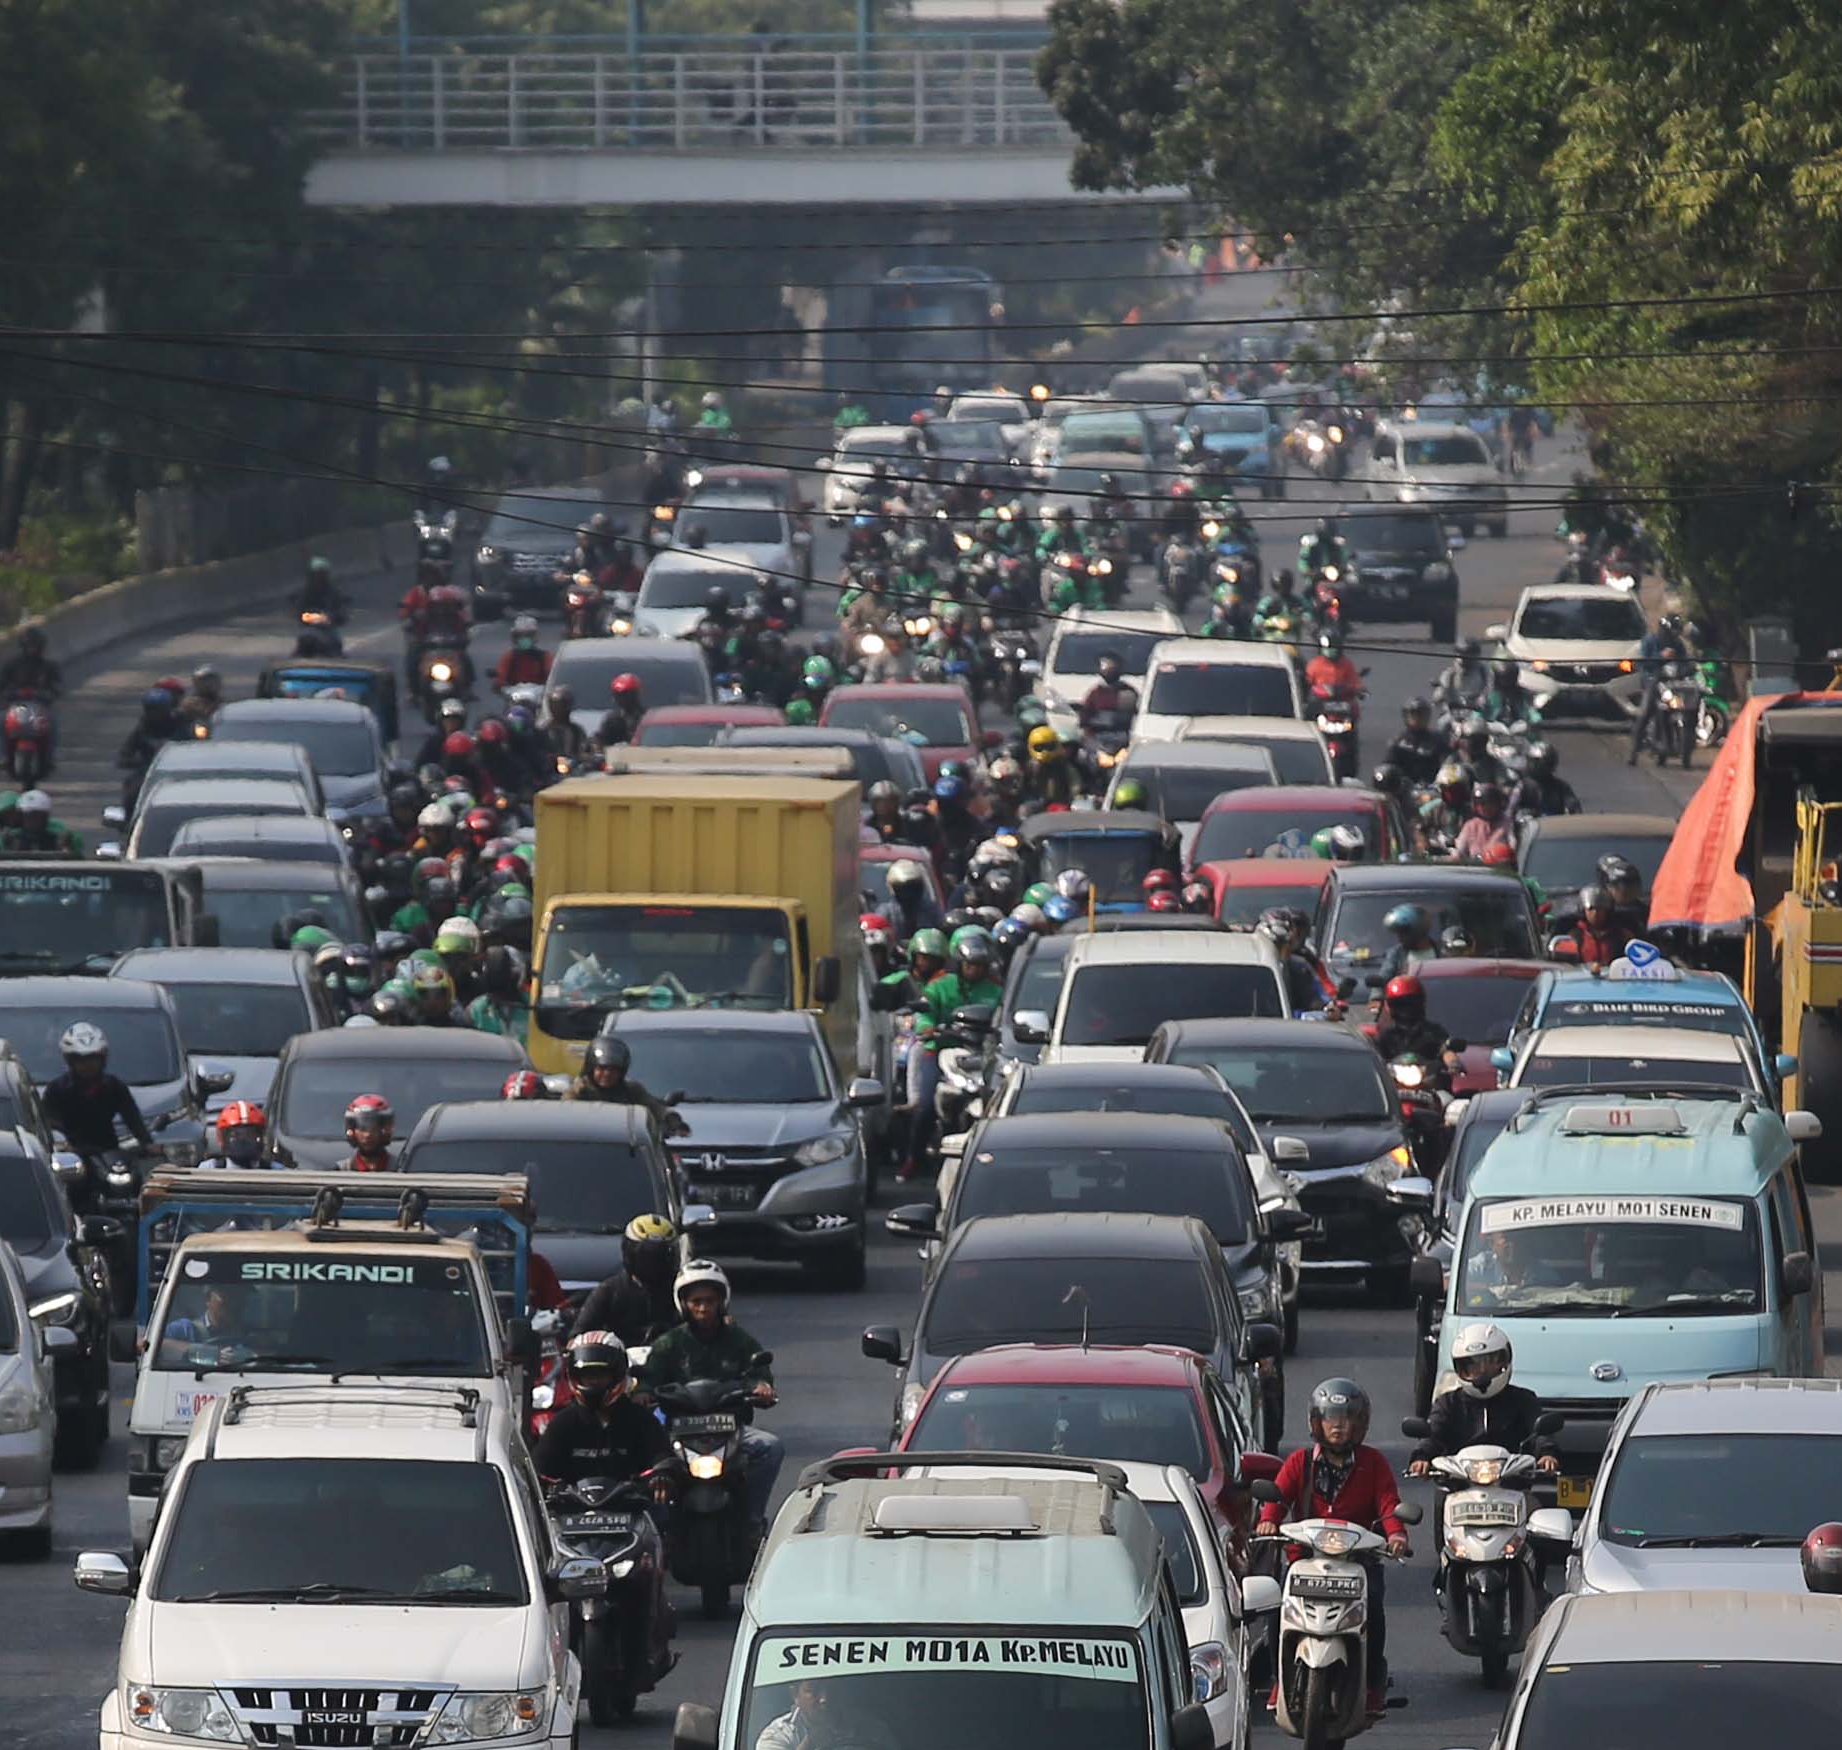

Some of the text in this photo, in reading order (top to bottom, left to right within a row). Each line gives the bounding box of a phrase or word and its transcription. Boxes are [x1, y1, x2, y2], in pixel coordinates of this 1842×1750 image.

[1620, 967, 1665, 978] TAKSI
[1594, 1003, 1726, 1017] BLUE BIRD GROUP
[1609, 1109, 1631, 1126] 01
[1539, 1201, 1606, 1218] MELAYU
[1658, 1202, 1713, 1220] SENEN
[241, 1262, 414, 1285] SRIKANDI
[779, 1641, 888, 1669] SENEN
[307, 1713, 361, 1724] ISUZU
